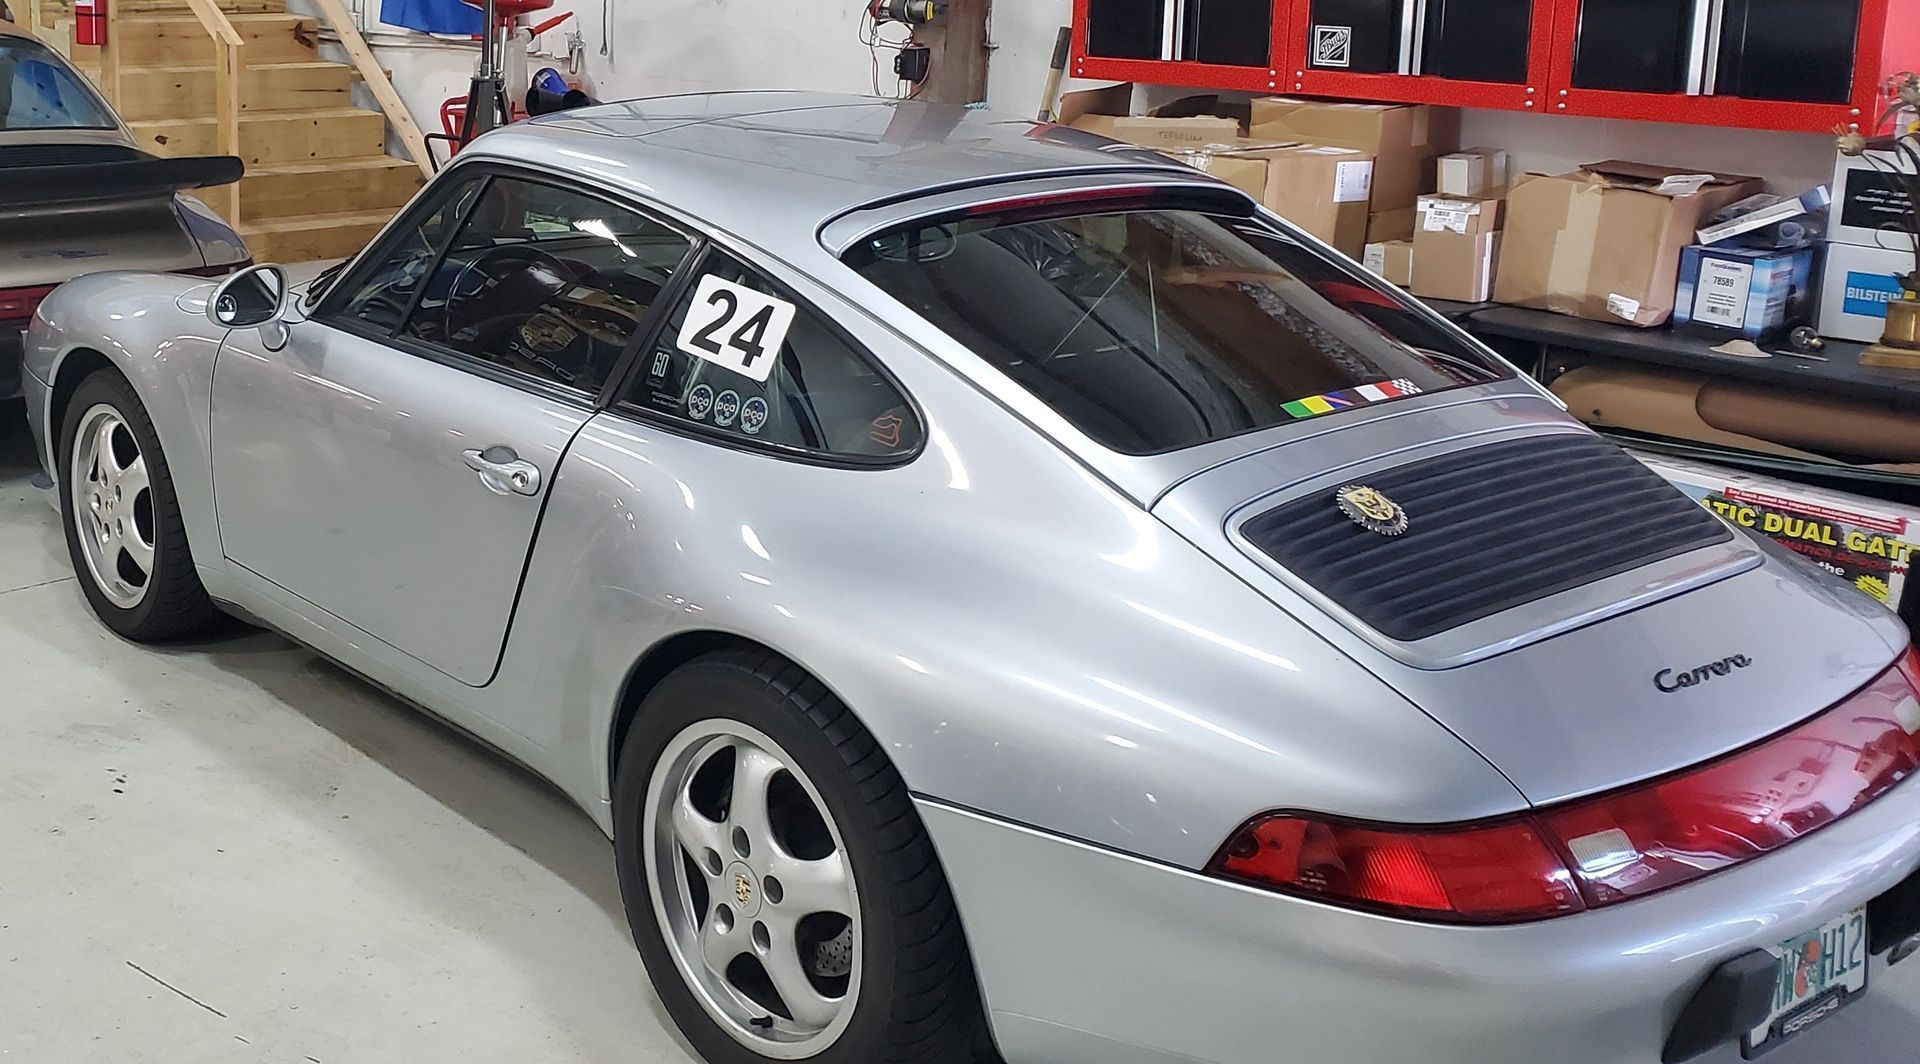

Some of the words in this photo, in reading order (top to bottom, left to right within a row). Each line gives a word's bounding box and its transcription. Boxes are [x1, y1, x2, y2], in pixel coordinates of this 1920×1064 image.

[1713, 275, 1735, 288] 78589
[689, 288, 776, 367] 24
[651, 351, 670, 378] 60
[691, 395, 710, 407] pca
[717, 401, 736, 413] pca
[744, 408, 764, 420] pca
[1763, 510, 1837, 547] DUAL
[1653, 653, 1752, 693] Carrera
[1783, 996, 1839, 1035] PORSCHE
